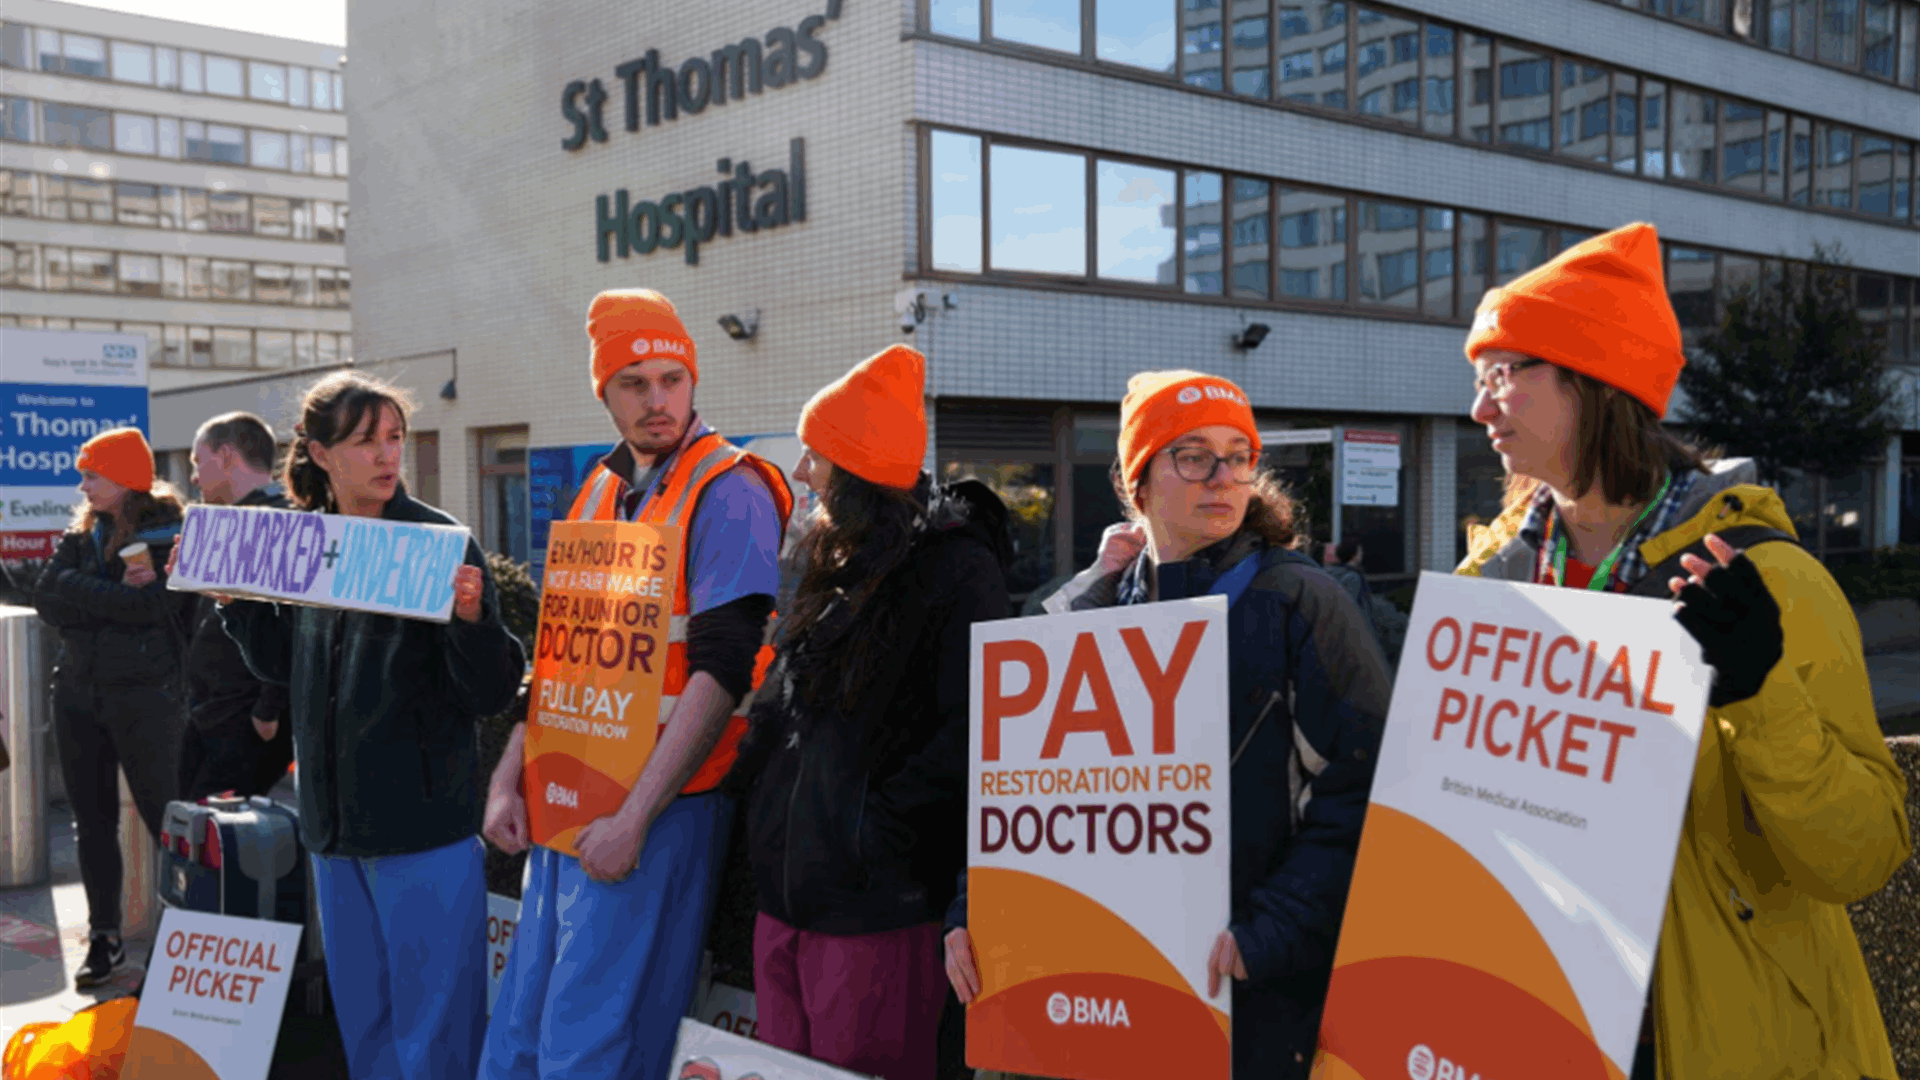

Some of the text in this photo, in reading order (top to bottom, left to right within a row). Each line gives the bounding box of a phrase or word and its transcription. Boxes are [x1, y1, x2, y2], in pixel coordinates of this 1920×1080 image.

[560, 78, 609, 151] St
[595, 136, 806, 267] Hospital
[653, 338, 685, 354] BMA
[16, 393, 95, 407] Welcome to
[2, 535, 47, 551] Hour
[178, 507, 326, 594] OVERWORKED
[641, 543, 667, 572] IS
[606, 573, 663, 598] WAGE
[543, 593, 661, 629] FOR A JUNIOR
[538, 621, 656, 674] DOCTOR
[1426, 616, 1675, 716] OFFICIAL
[540, 678, 634, 721] FULL PAY
[981, 620, 1209, 762] PAY
[592, 722, 629, 740] NOW
[1433, 687, 1637, 784] PICKET
[981, 763, 1212, 796] RESTORATION FOR
[980, 802, 1212, 855] DOCTORS
[1476, 785, 1519, 810] Medical
[1520, 799, 1588, 830] Association
[165, 930, 282, 973] OFFICIAL
[168, 964, 265, 1005] PICKET
[1074, 996, 1131, 1028] BMA
